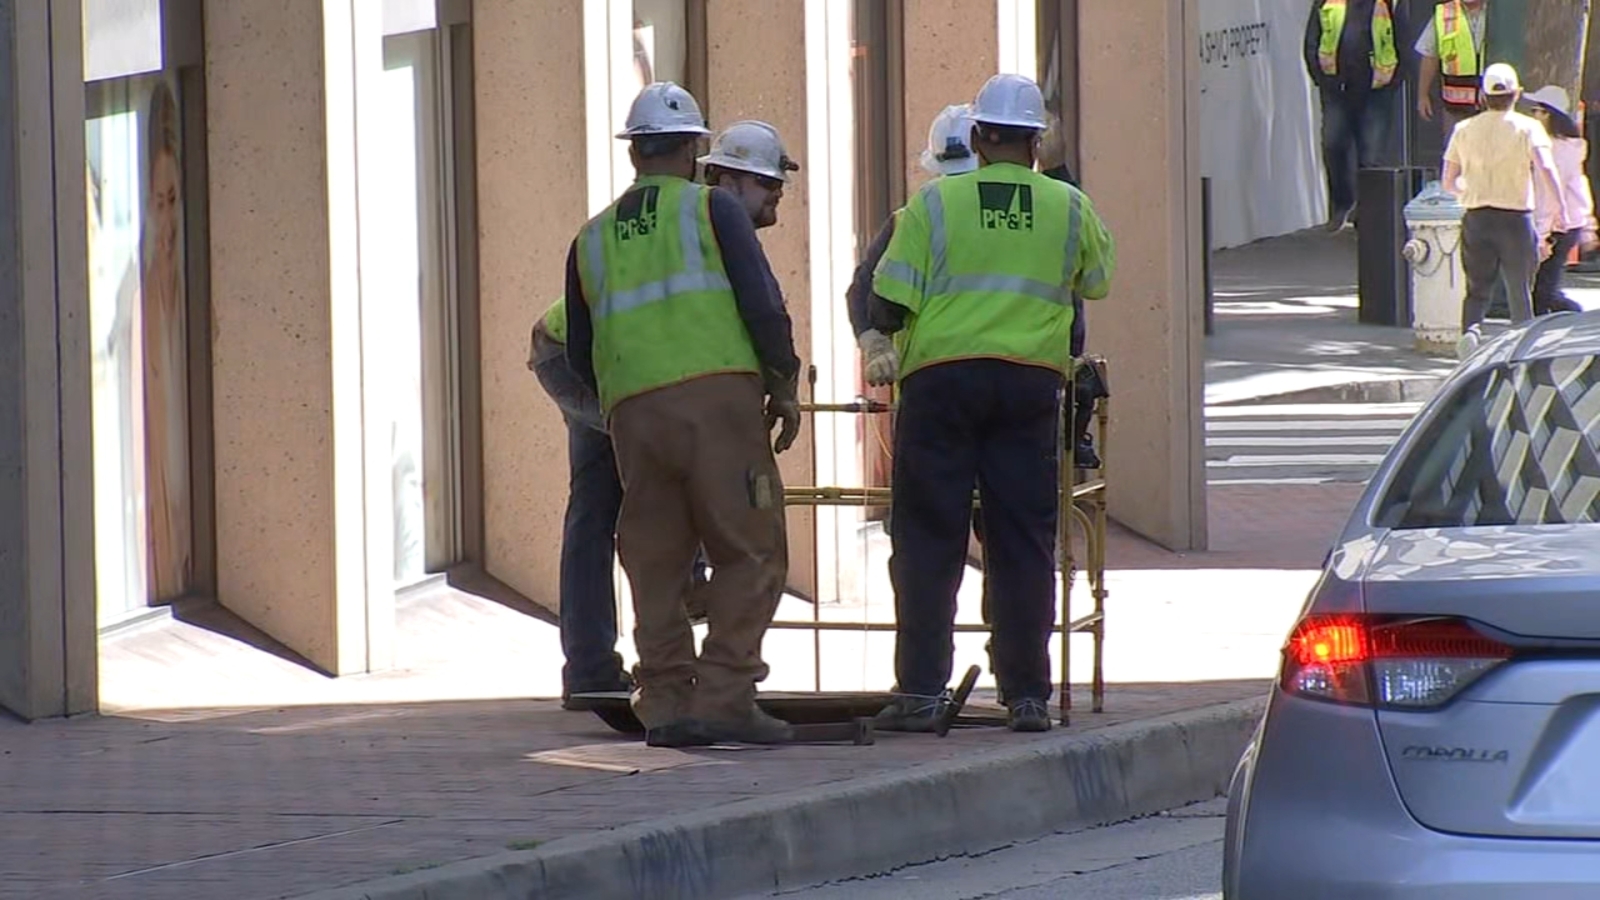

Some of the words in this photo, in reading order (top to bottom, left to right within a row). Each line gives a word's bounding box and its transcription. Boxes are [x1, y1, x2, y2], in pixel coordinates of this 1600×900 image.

[1230, 22, 1270, 58] PROPERTY
[614, 212, 657, 241] PG&E
[980, 208, 1033, 231] PG&E
[1400, 744, 1509, 763] COROLLA
